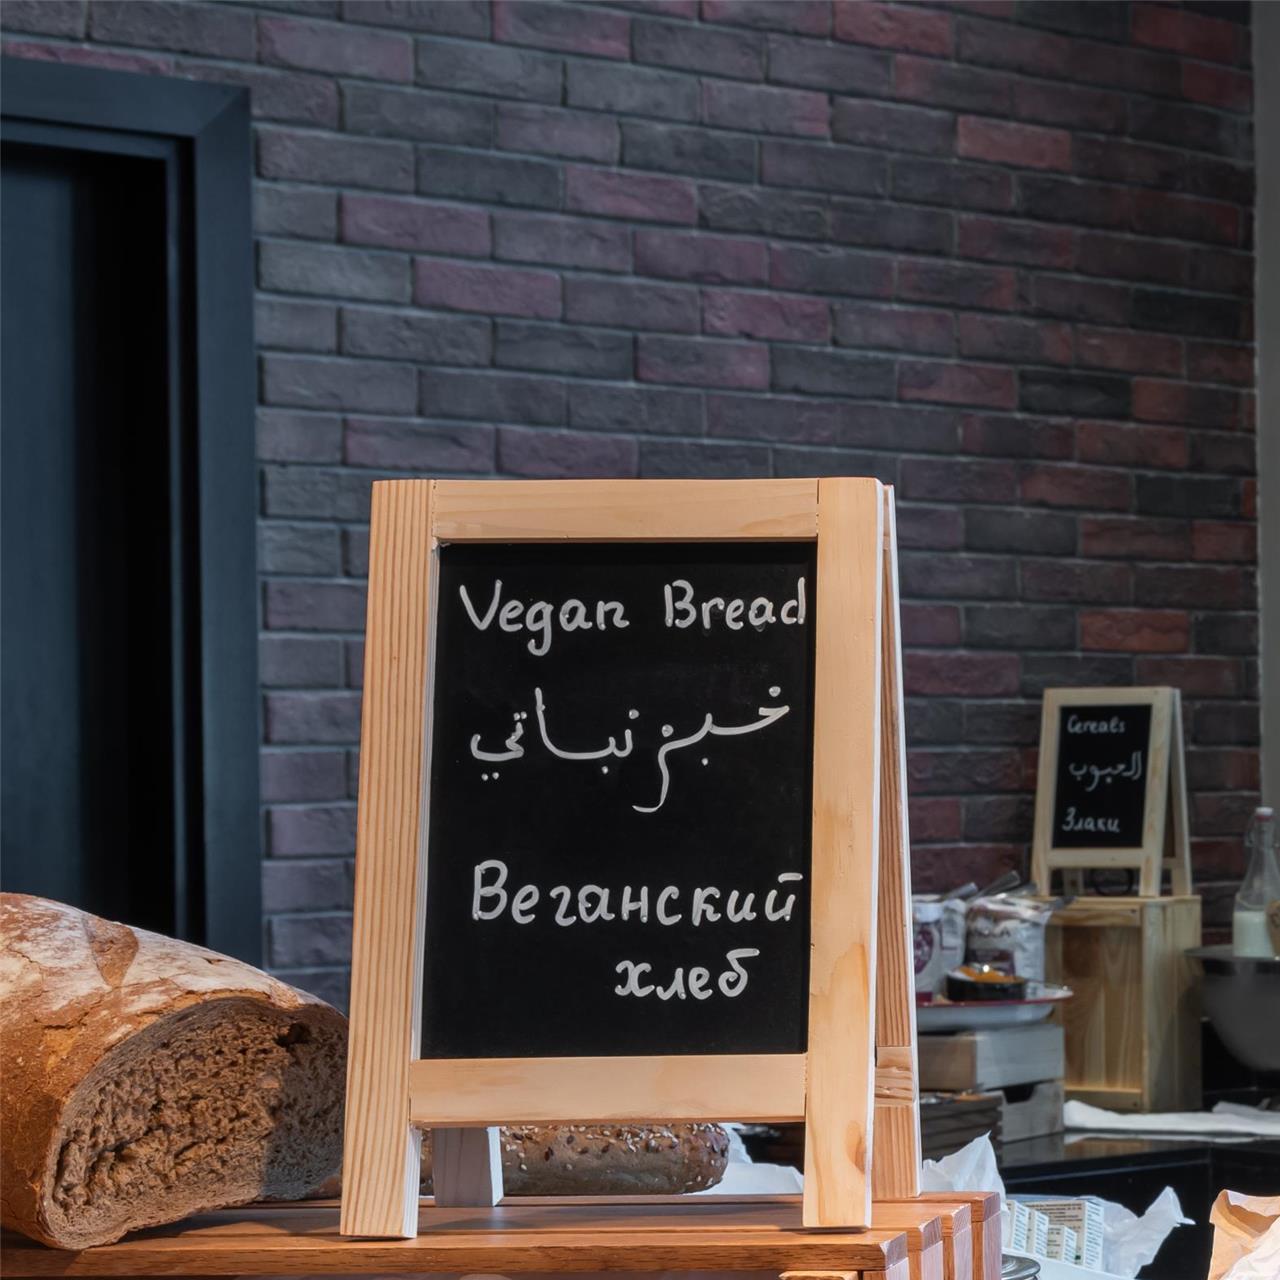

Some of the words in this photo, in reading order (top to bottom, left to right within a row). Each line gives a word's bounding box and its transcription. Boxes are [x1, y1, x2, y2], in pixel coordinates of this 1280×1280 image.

[458, 578, 631, 657] Vegan
[663, 576, 806, 631] Bread
[470, 687, 641, 782] نباتي
[632, 685, 792, 815] خبز
[1067, 714, 1126, 734] Cereals
[1068, 751, 1143, 792] الحبوب
[1061, 806, 1121, 834] Злаки
[471, 859, 804, 927] Веганский
[614, 948, 760, 1002] хлеб
